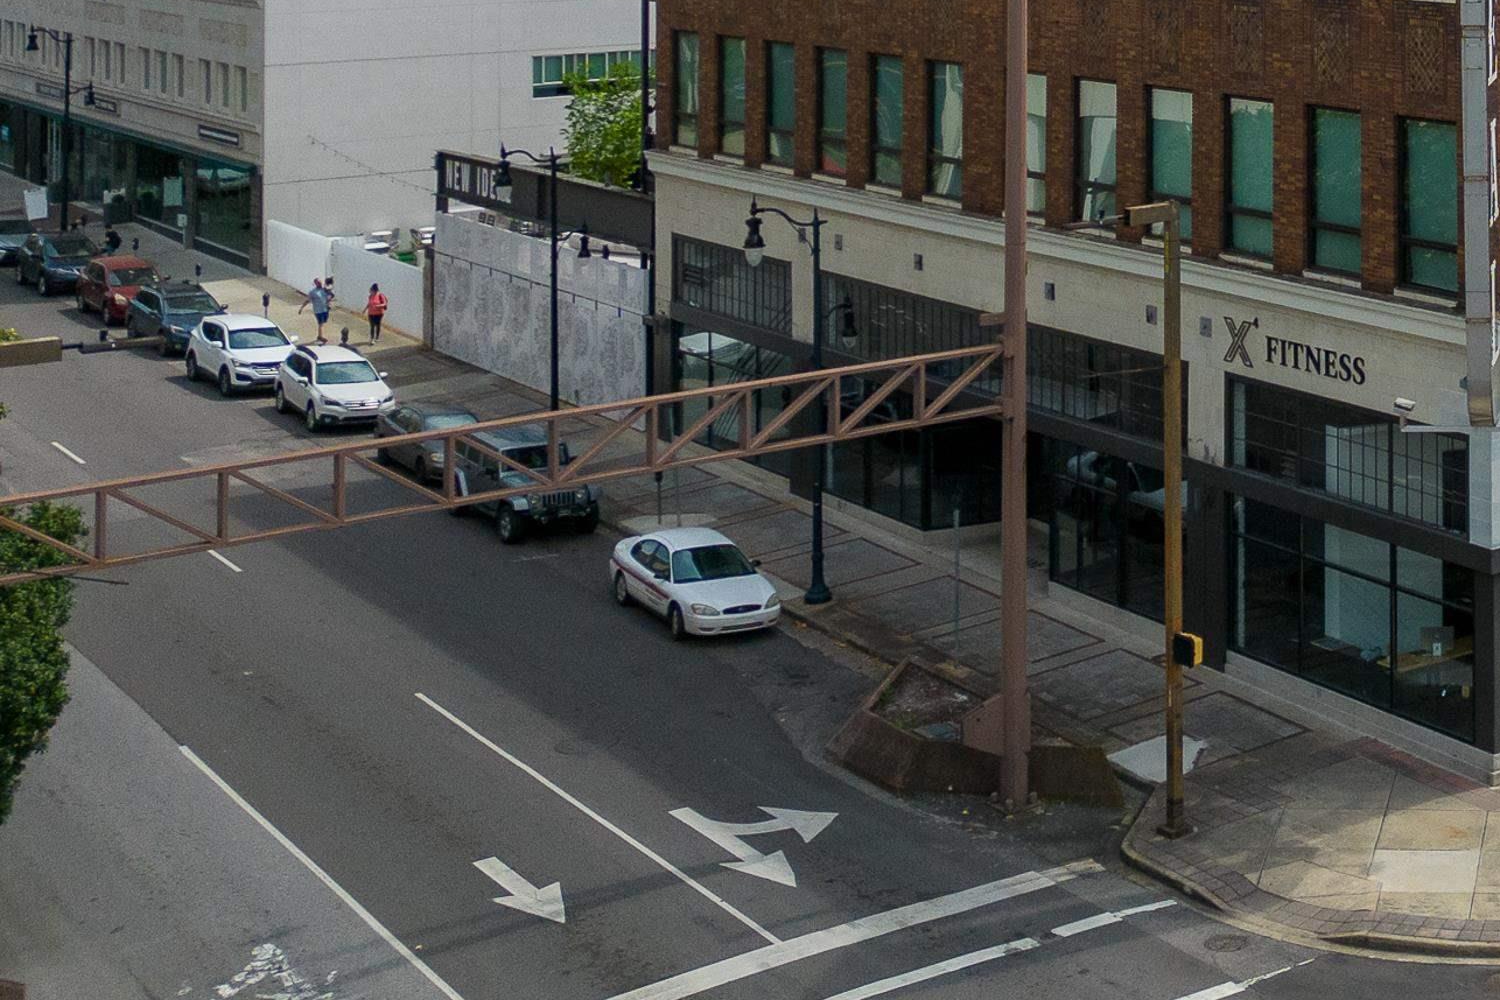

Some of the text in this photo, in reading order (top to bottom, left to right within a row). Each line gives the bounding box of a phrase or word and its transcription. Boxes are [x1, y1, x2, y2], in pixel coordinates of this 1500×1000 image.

[446, 160, 470, 193] NEW
[1223, 316, 1366, 385] X FITNESS
